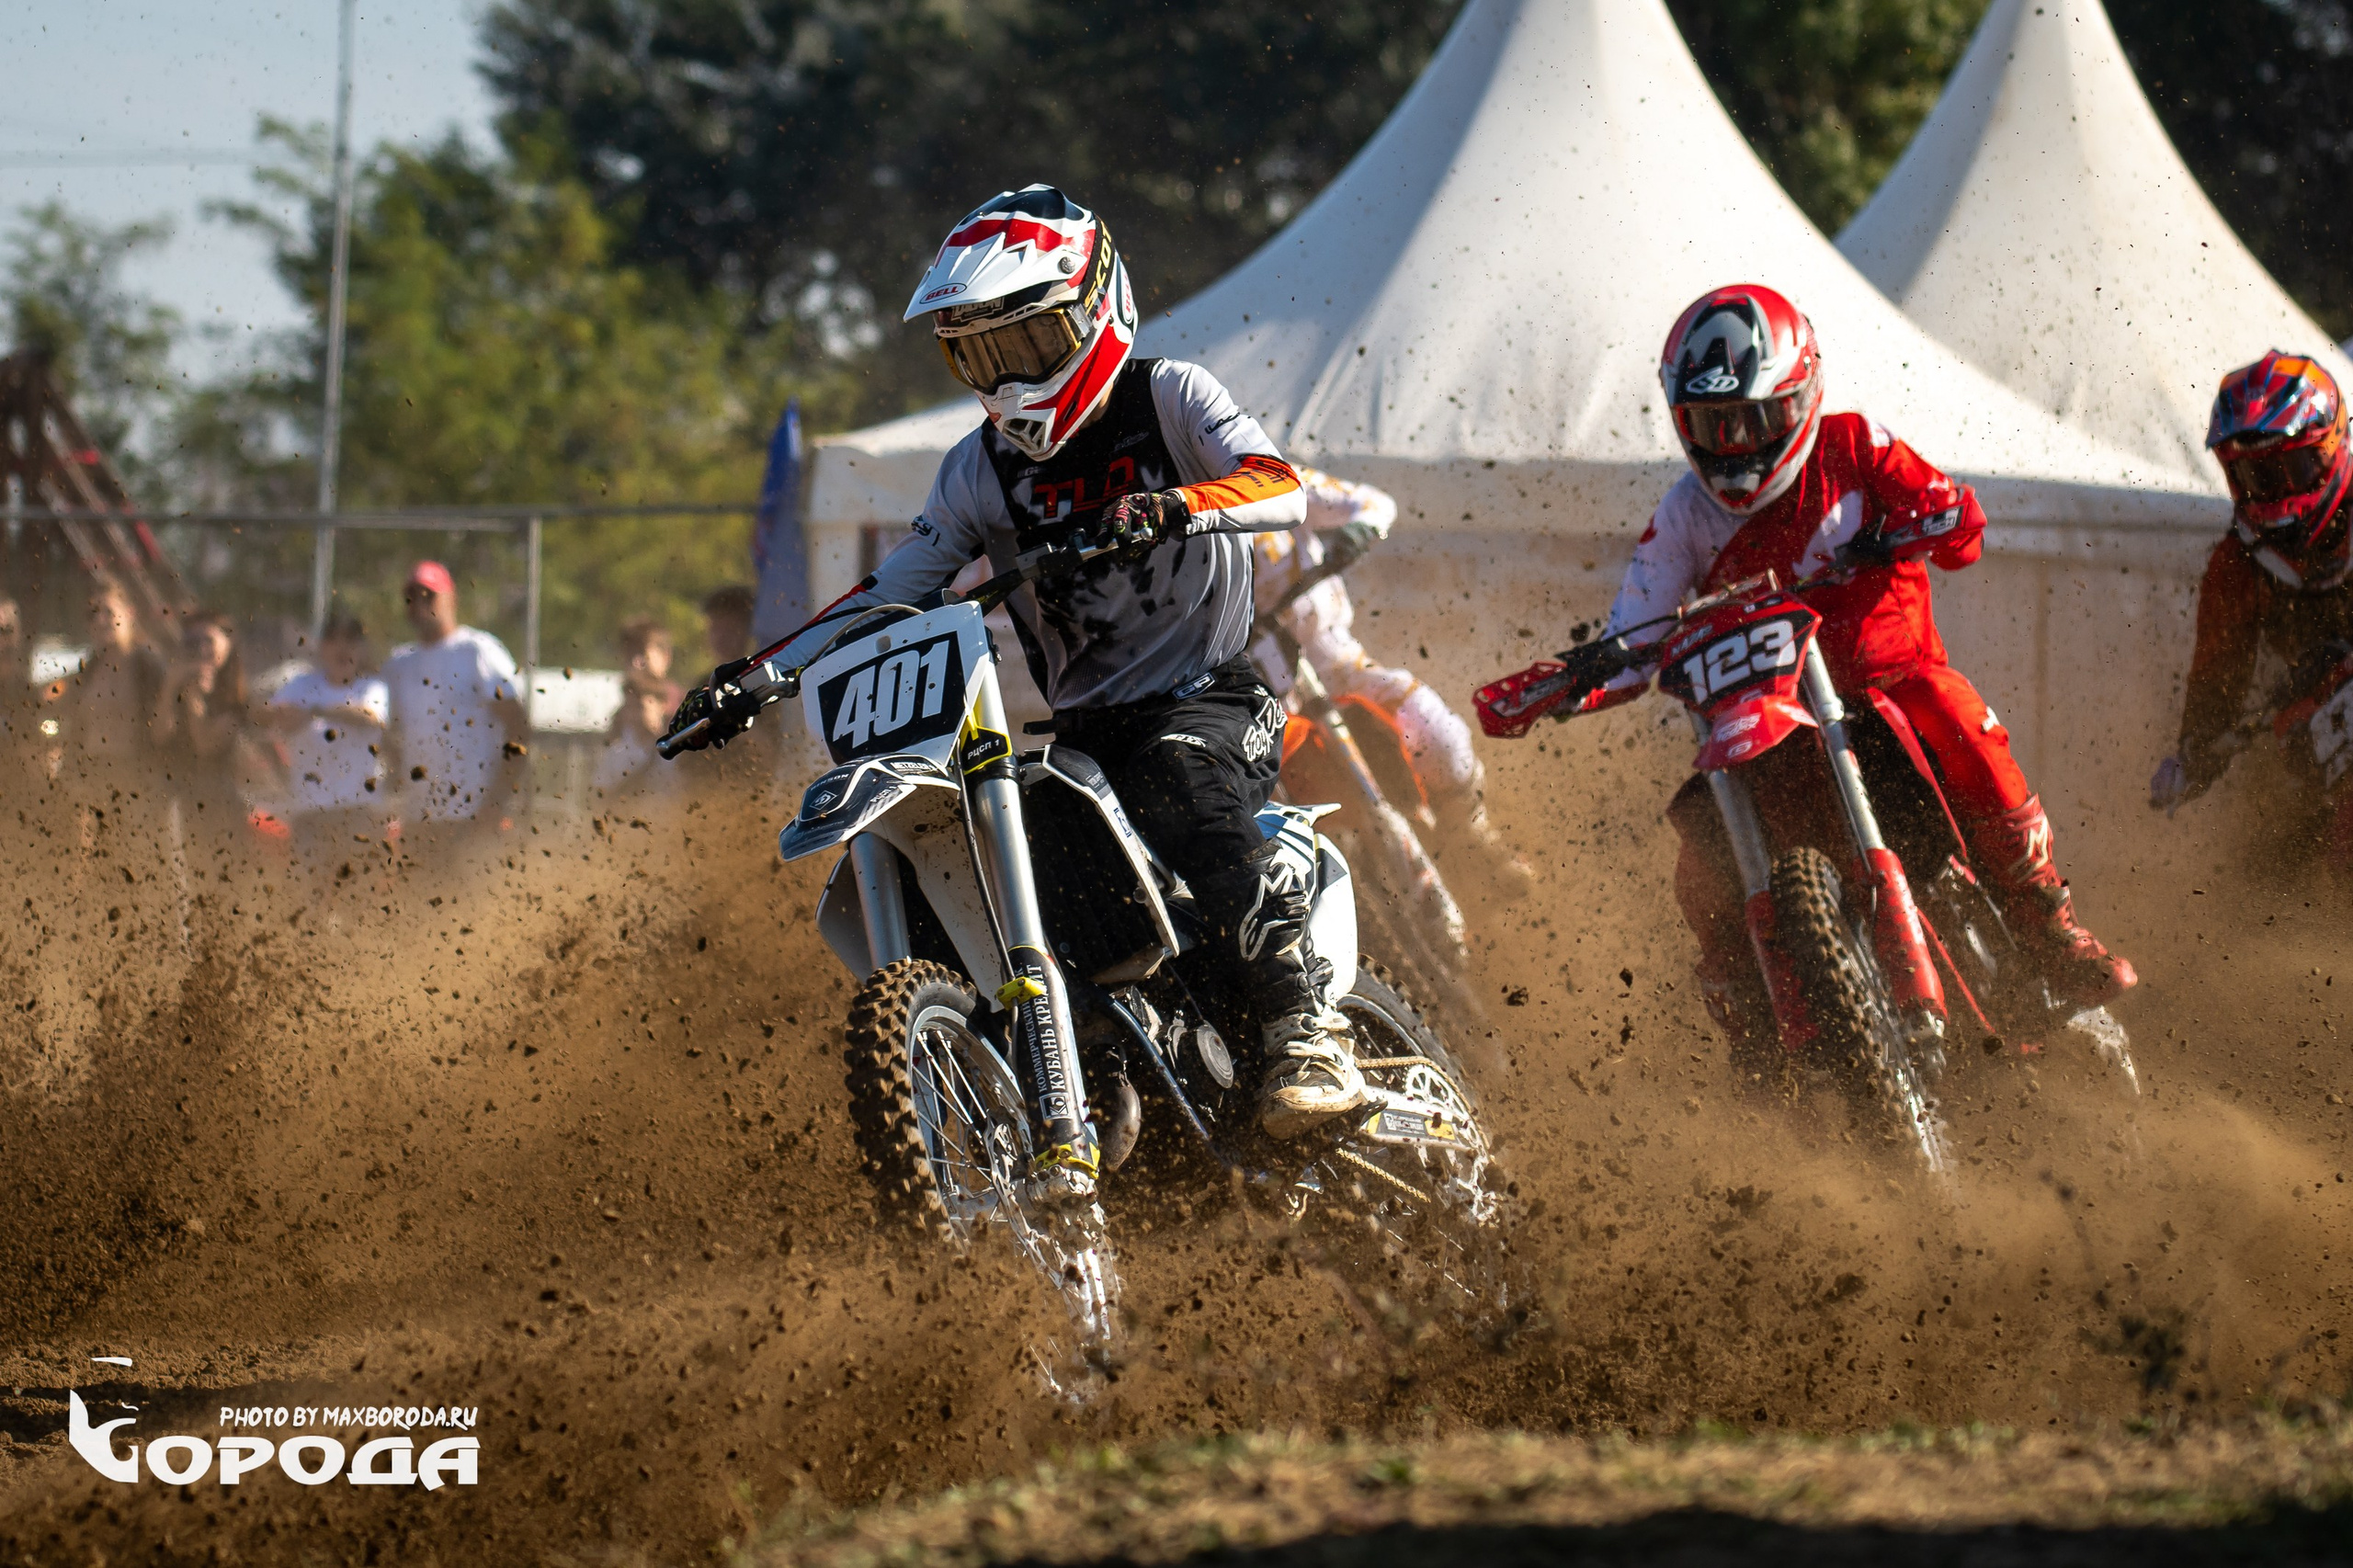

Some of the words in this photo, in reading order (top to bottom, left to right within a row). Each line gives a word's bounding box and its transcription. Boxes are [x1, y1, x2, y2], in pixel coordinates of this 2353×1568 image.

[926, 286, 959, 301] BELL
[1683, 619, 1797, 705] 123
[833, 640, 950, 748] 401
[967, 741, 992, 760] РЦСП
[1027, 964, 1052, 1027] КРЕИТ
[1040, 1028, 1066, 1091] КУБАНЬ
